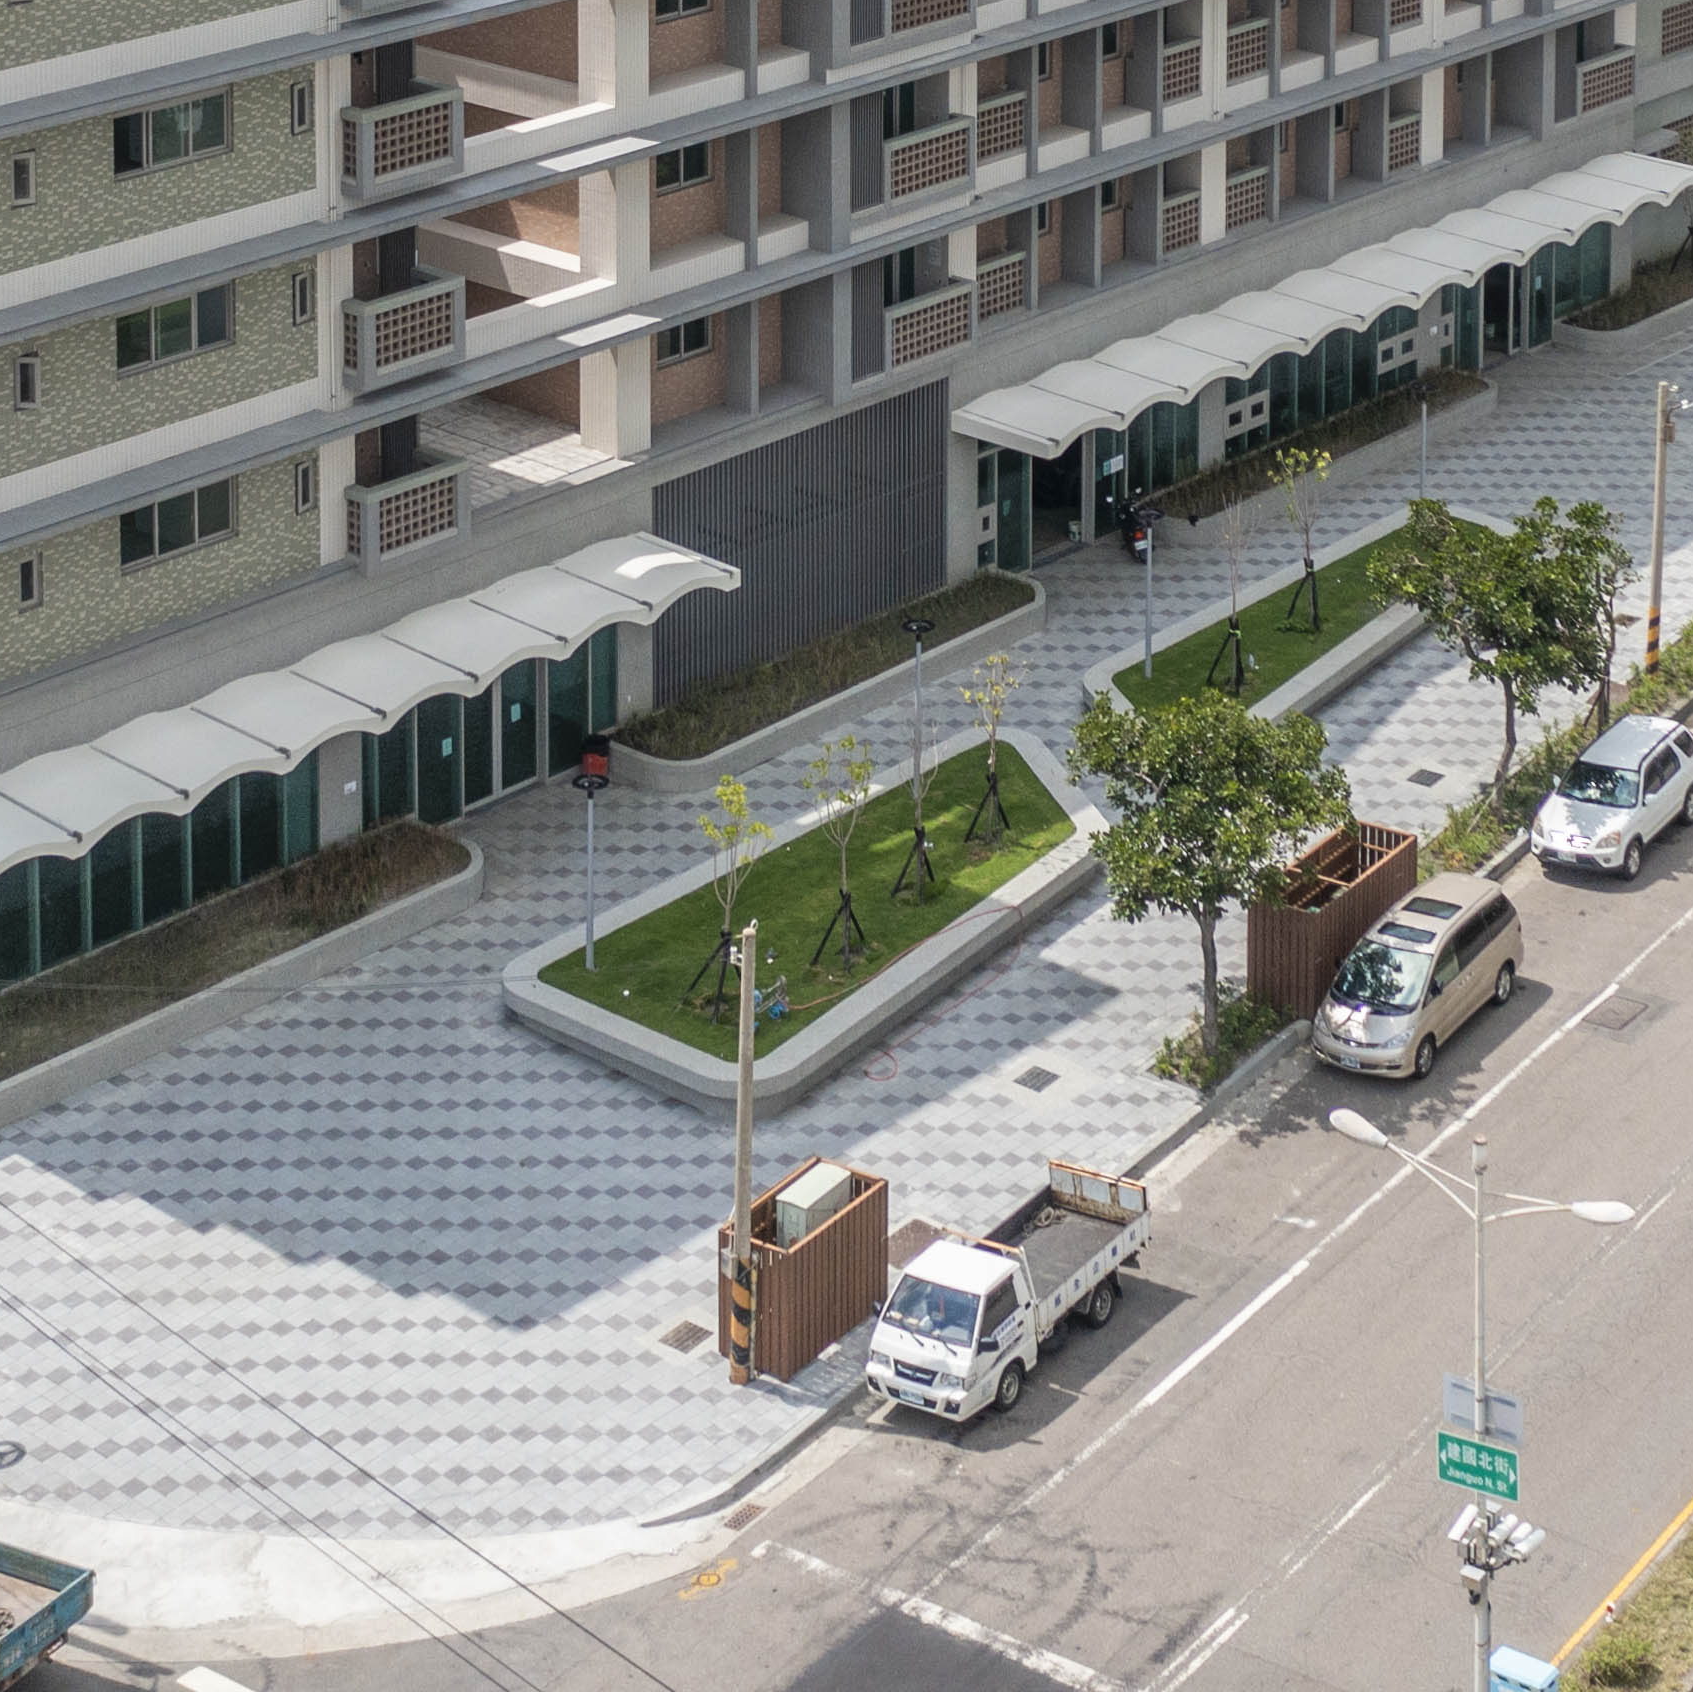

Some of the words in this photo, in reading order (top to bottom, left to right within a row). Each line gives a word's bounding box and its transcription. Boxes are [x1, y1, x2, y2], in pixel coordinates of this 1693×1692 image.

[1447, 1441, 1509, 1476] 建國北街
[1447, 1466, 1484, 1486] Jianguo
